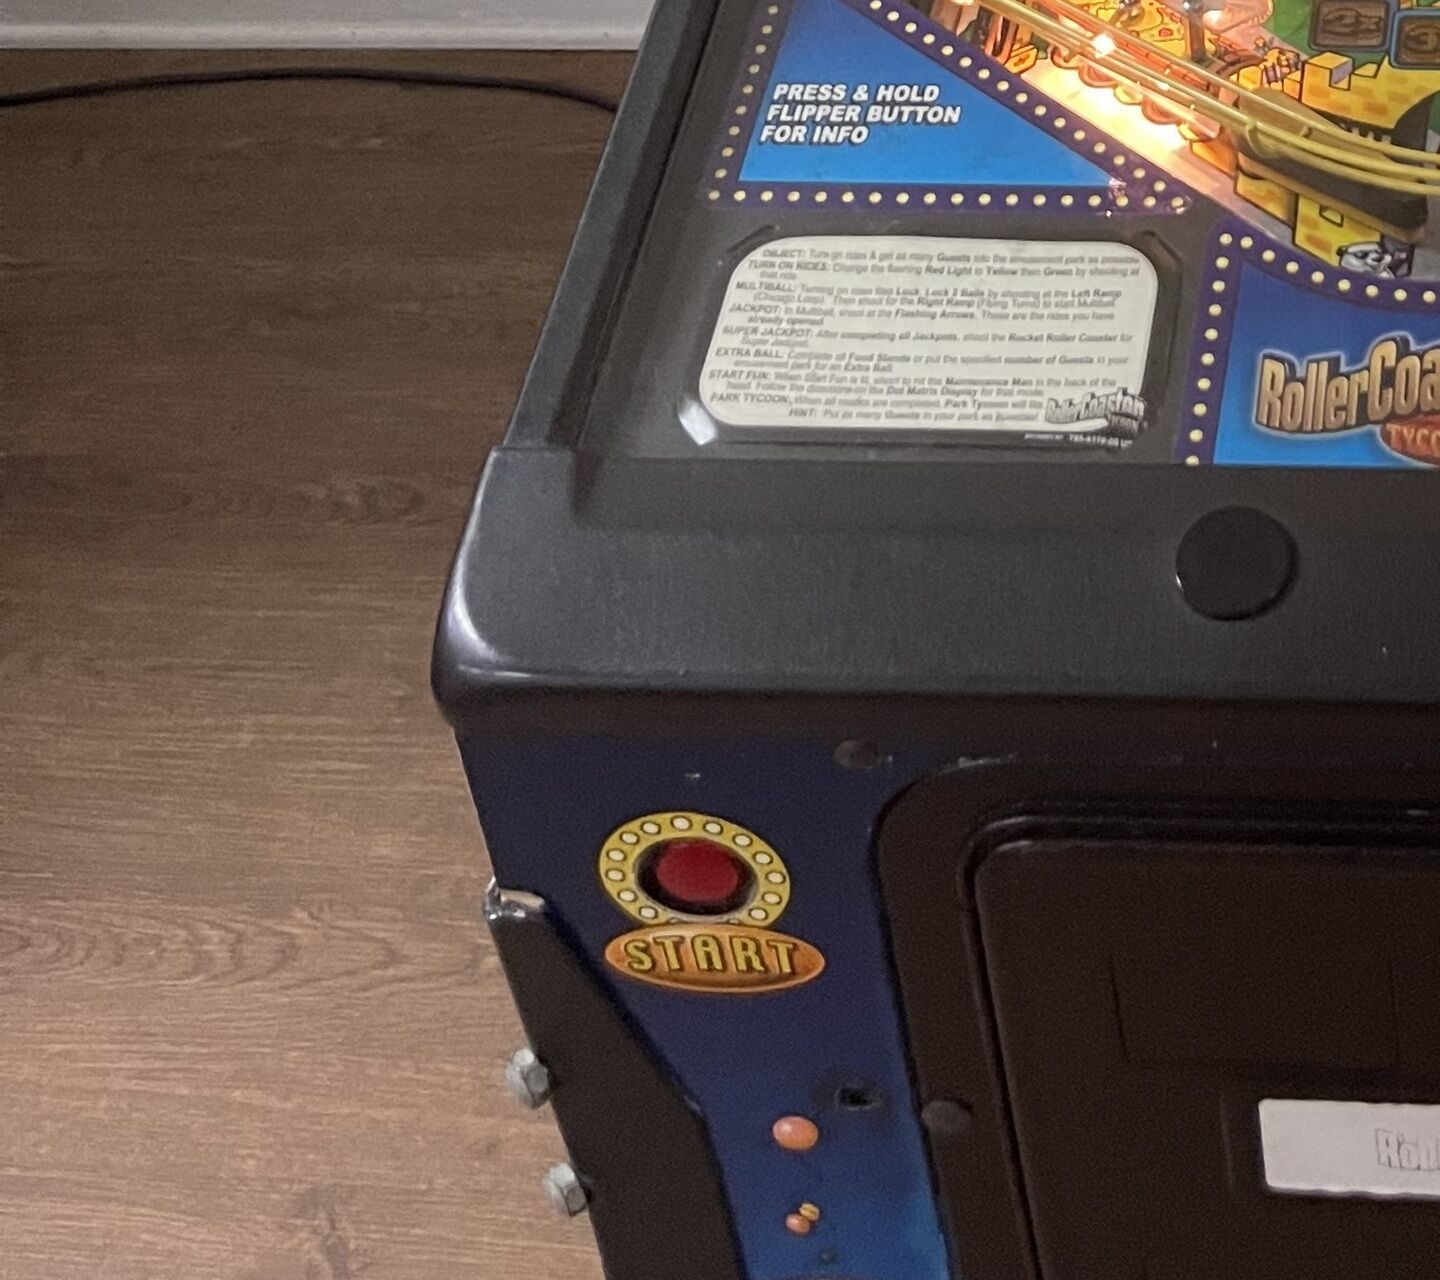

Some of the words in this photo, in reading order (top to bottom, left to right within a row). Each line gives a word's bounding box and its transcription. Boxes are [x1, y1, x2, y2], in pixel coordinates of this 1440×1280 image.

[773, 84, 847, 103] PRESS
[852, 85, 869, 102] &
[876, 84, 940, 103] HOLD
[766, 104, 860, 124] FLIPPER
[866, 105, 961, 124] BUTTON
[759, 125, 806, 144] FOR
[811, 125, 869, 145] INFO
[622, 934, 800, 977] START
